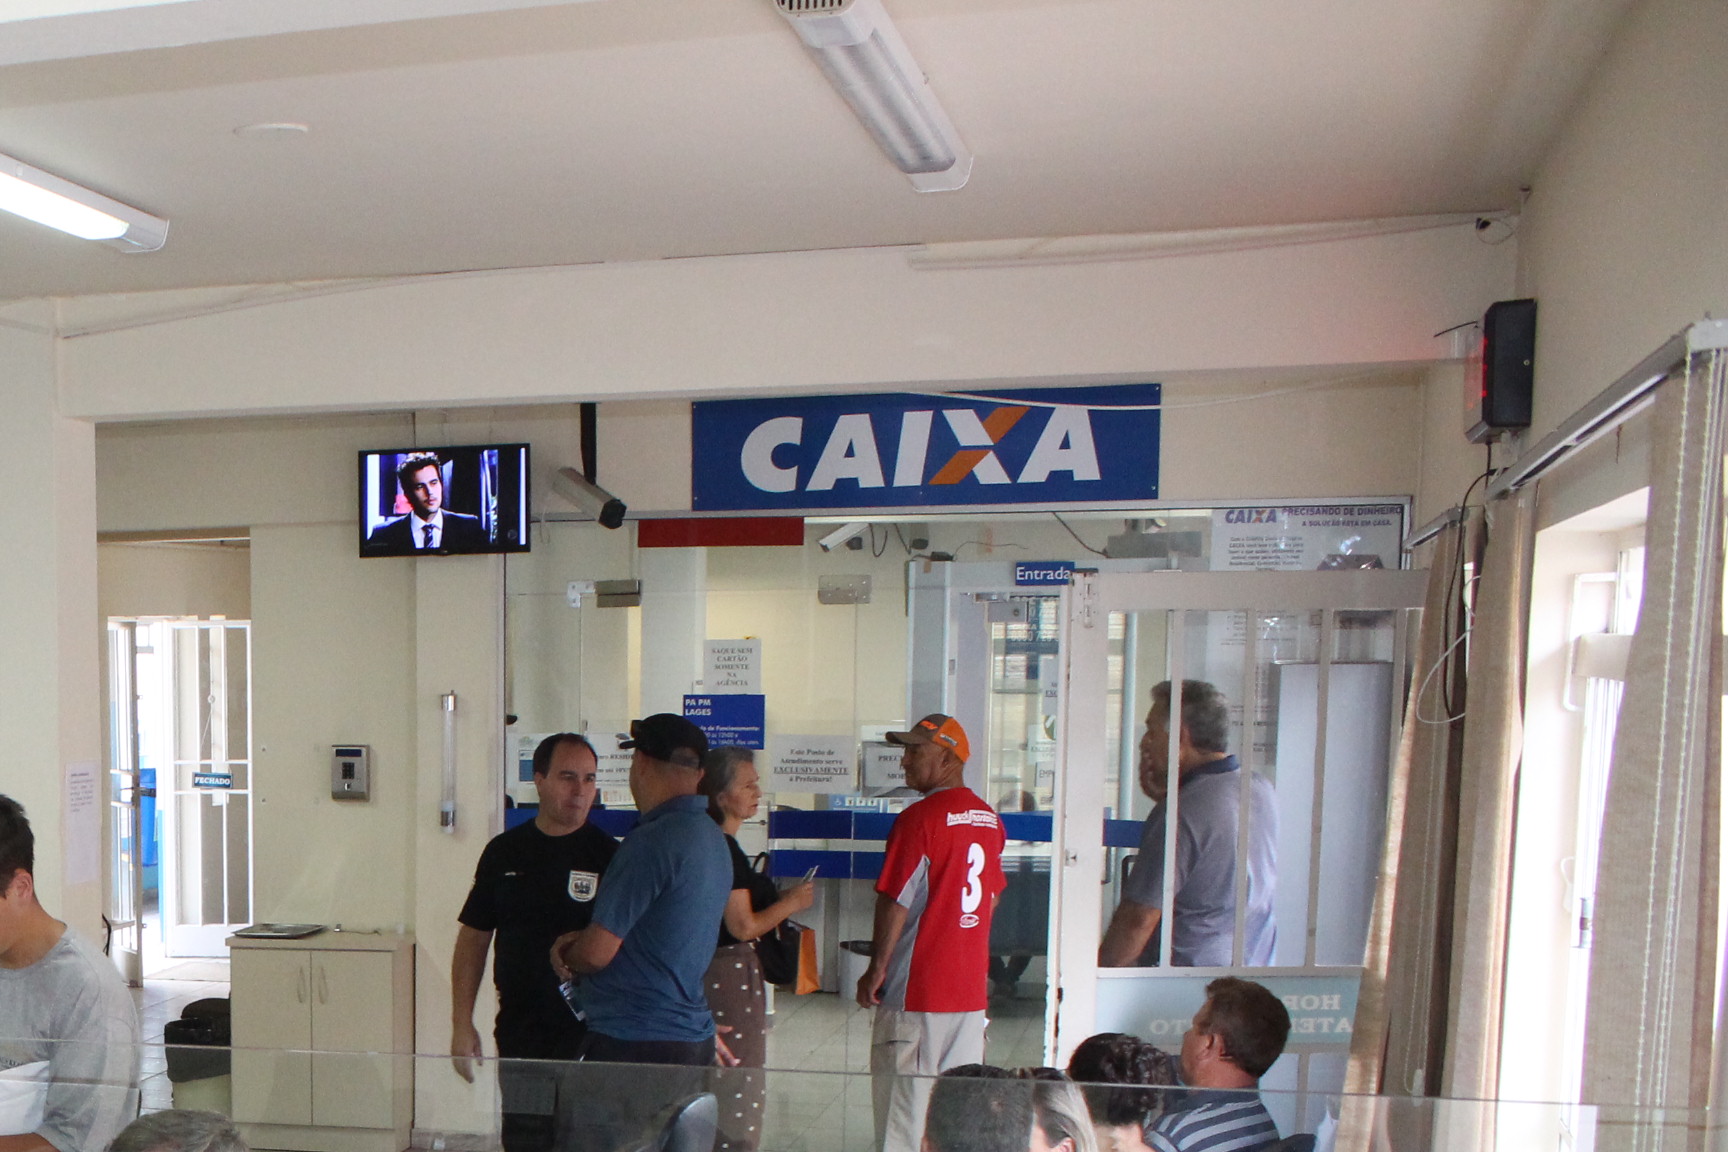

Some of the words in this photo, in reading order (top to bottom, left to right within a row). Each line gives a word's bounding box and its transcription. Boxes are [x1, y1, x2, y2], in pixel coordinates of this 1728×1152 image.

[740, 406, 1101, 493] CAIXA
[1281, 507, 1341, 516] PRECISANDO
[1343, 507, 1355, 516] DE
[1357, 506, 1402, 515] DINHEIRO
[1225, 509, 1277, 524] CAIXA
[1016, 567, 1071, 580] Entrada
[717, 654, 748, 662] CARTÃO
[716, 678, 748, 686] AGÊNCIA
[685, 708, 712, 716] LAGES
[781, 757, 824, 765] Atendimento
[773, 766, 849, 774] EXCLUSIVAMENTE
[194, 776, 230, 786] FECHADO
[961, 842, 985, 913] 3
